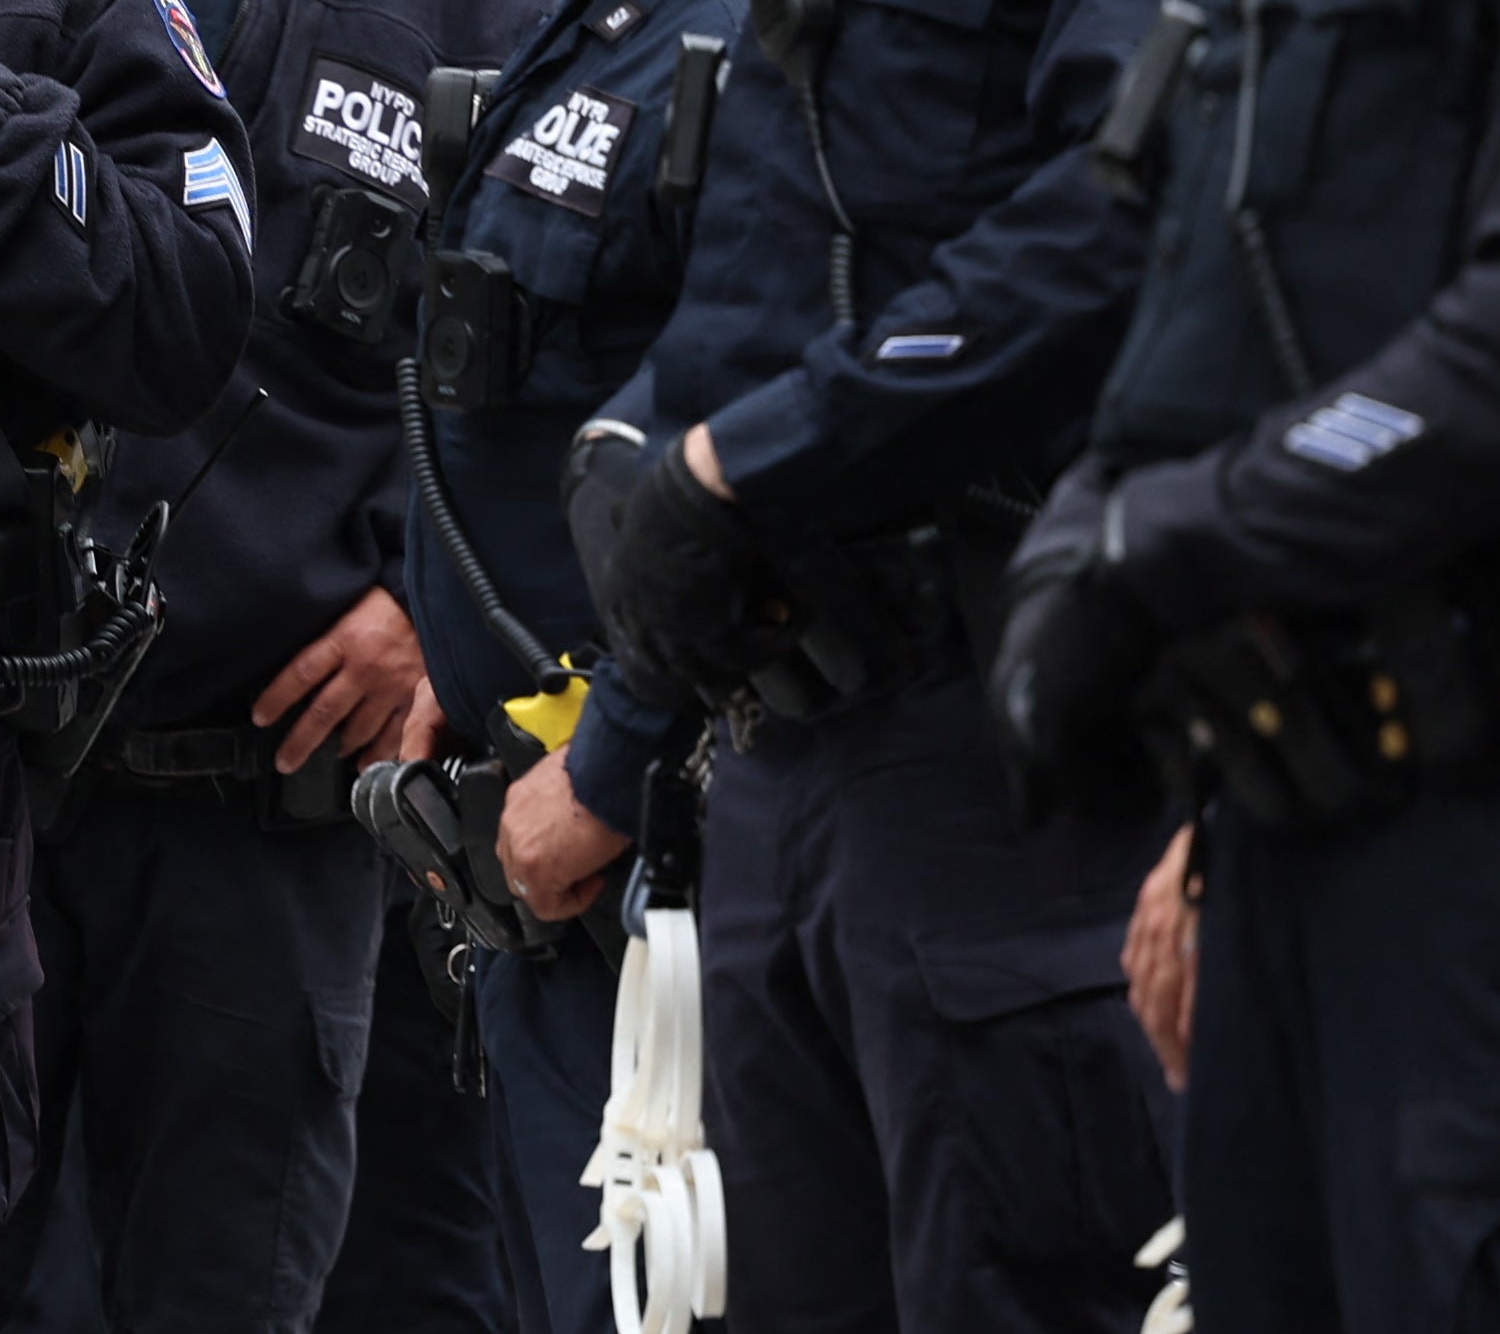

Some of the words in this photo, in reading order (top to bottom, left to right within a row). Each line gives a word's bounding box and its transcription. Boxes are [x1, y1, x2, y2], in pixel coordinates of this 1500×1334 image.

[370, 81, 415, 117] NYPD
[303, 114, 382, 160] STRATEGIC
[313, 79, 424, 167] POLIC
[349, 150, 402, 187] GROUP
